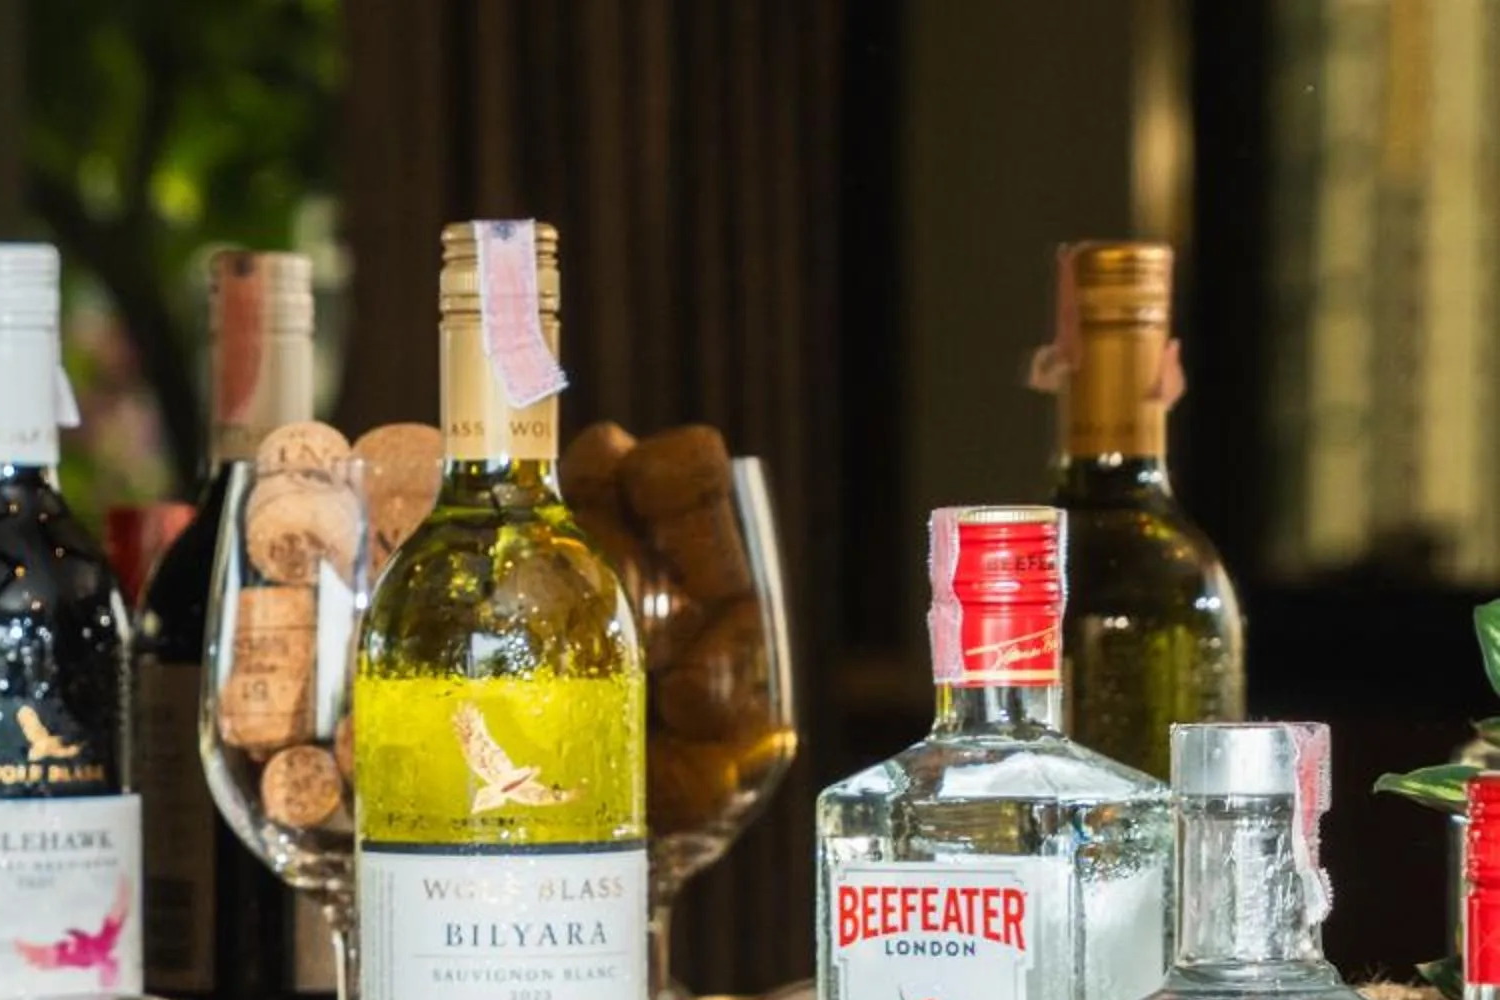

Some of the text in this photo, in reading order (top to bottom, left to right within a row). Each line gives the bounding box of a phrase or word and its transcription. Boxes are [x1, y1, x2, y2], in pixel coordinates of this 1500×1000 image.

[538, 876, 624, 900] BLASS
[837, 885, 1025, 951] BEEFEATER
[443, 919, 608, 949] BILYARA
[884, 939, 977, 958] LONDON
[432, 965, 617, 983] SAUVIGNON BLANC
